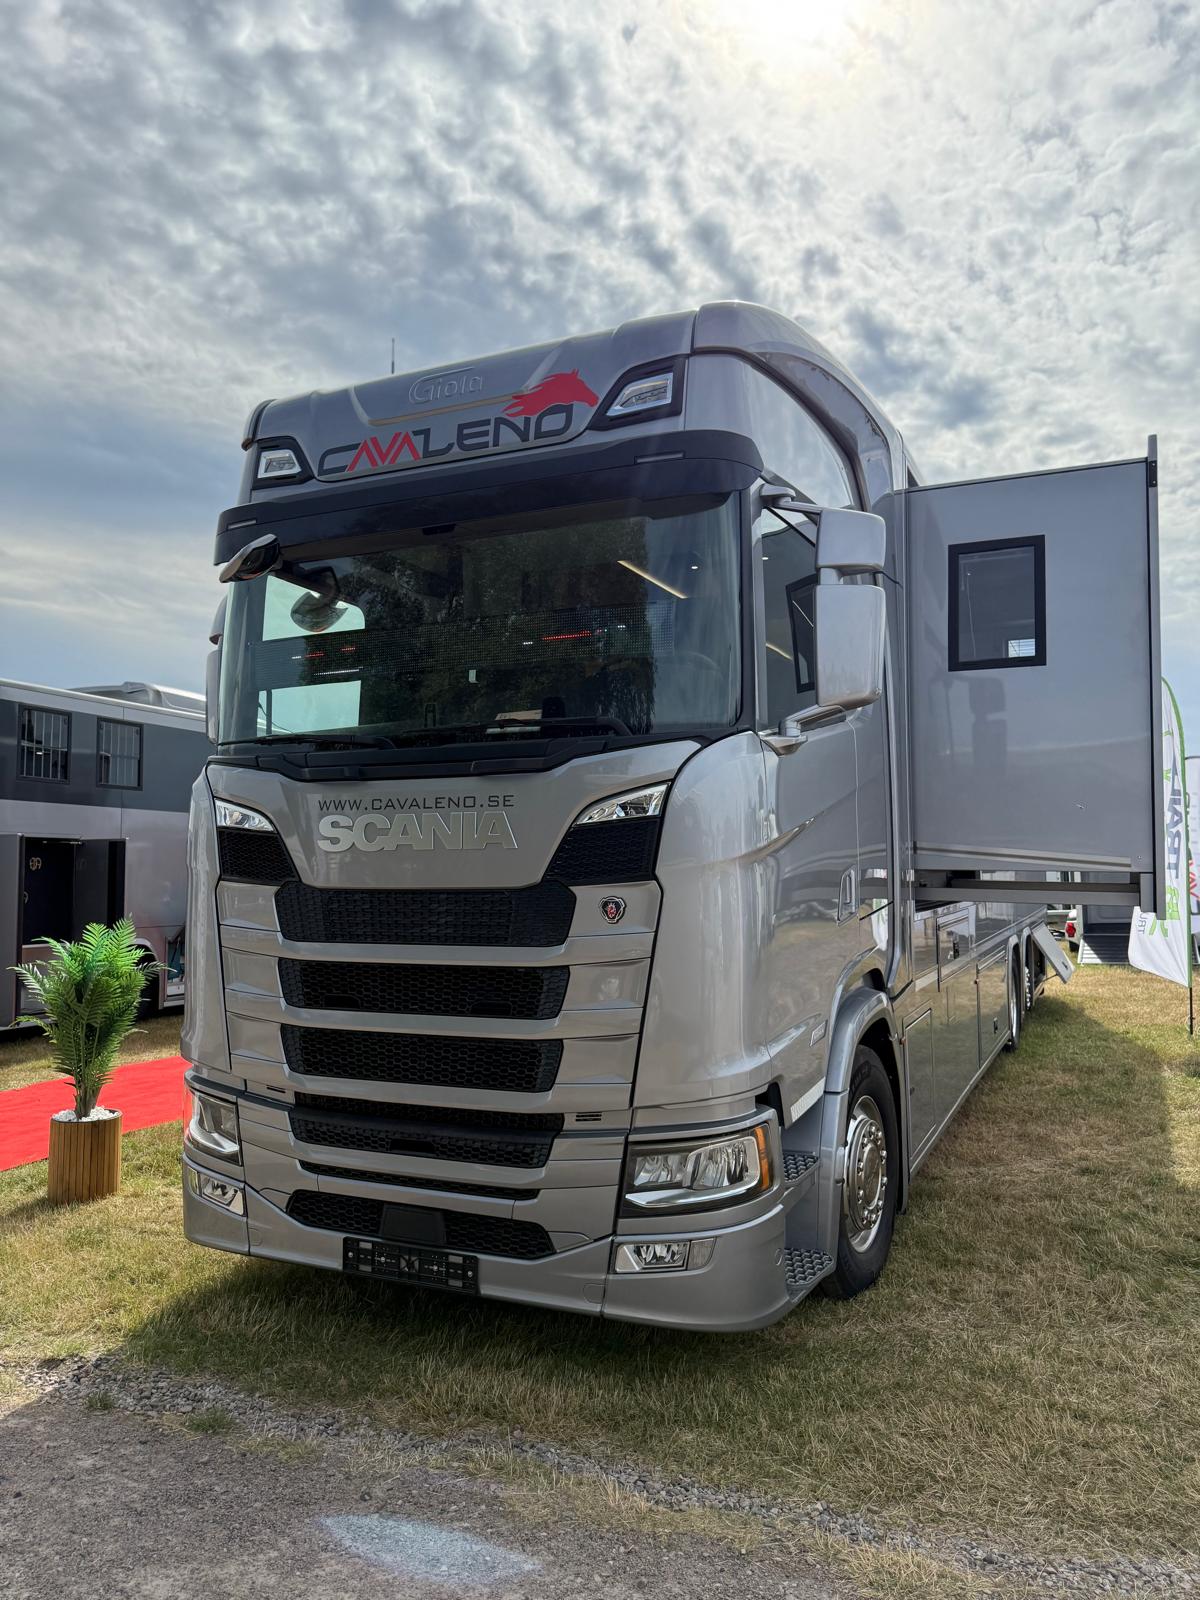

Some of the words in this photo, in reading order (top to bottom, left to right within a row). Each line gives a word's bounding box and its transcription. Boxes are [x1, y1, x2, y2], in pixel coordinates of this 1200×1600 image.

[319, 403, 575, 476] CAVALENO
[318, 795, 515, 812] WWW.CAVALENO.SE
[317, 811, 518, 853] SCANIA
